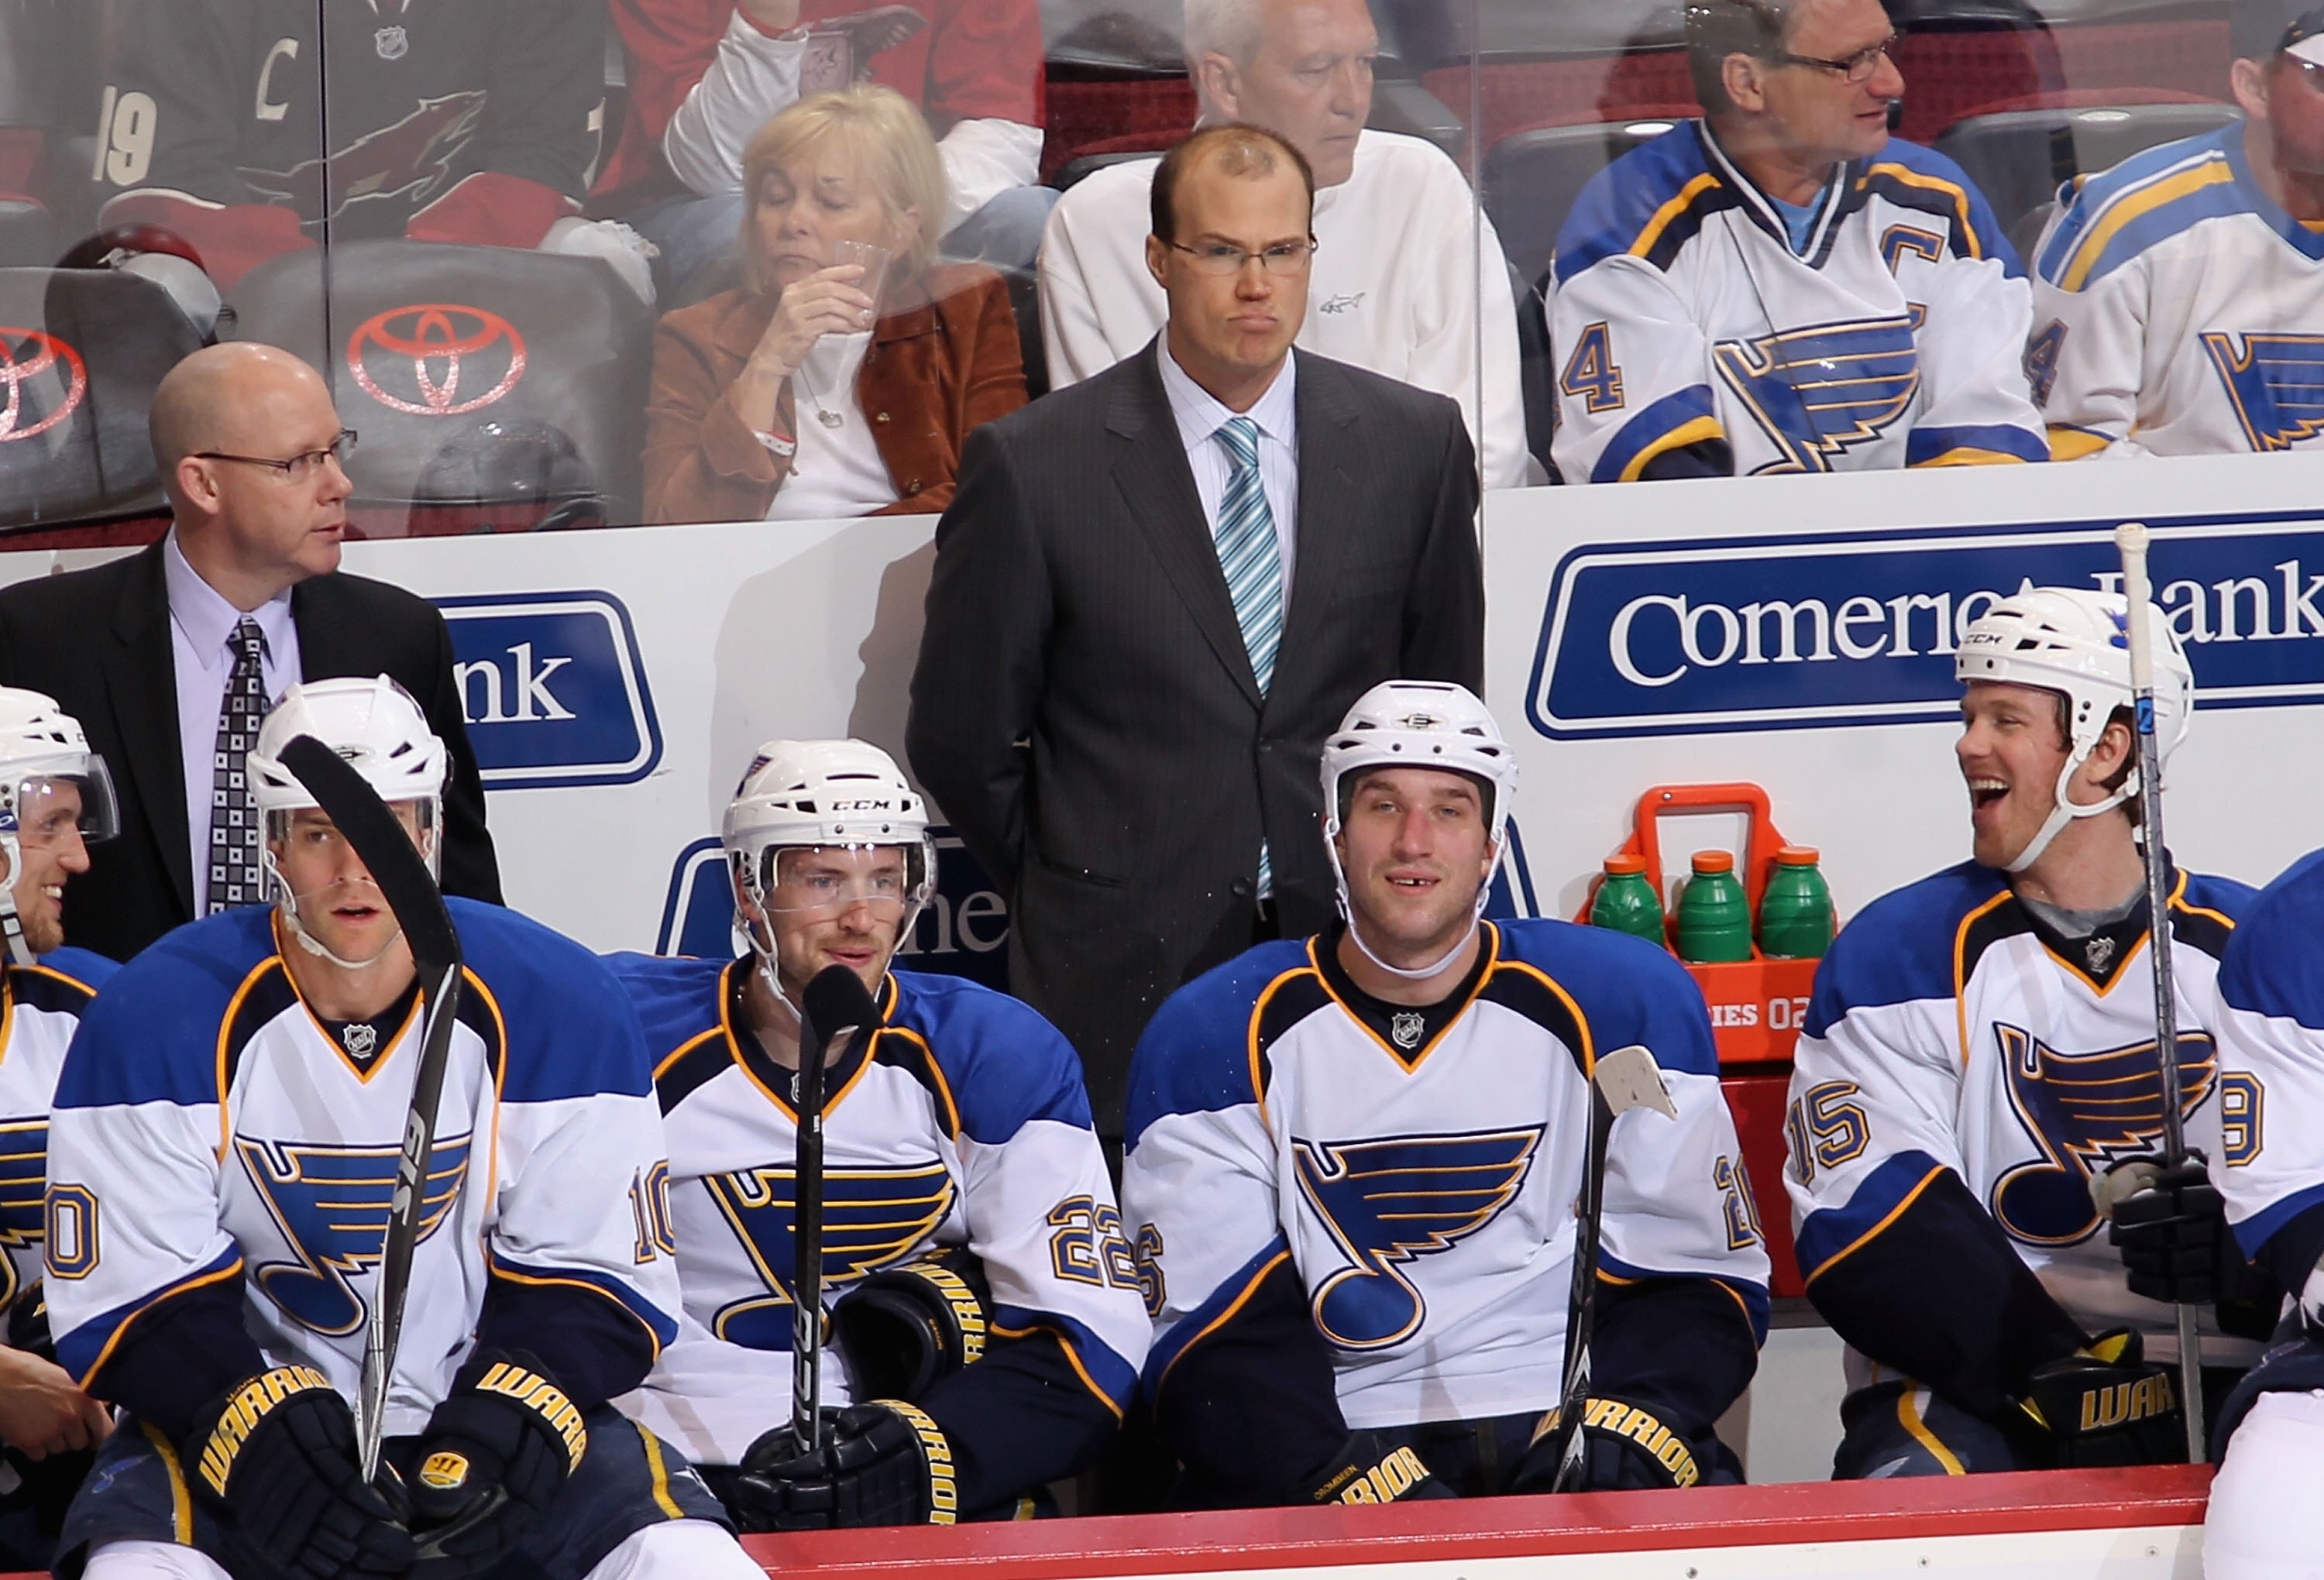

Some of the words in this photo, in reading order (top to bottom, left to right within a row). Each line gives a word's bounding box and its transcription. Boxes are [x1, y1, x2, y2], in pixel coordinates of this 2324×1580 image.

[256, 36, 300, 120] C
[92, 84, 157, 186] 19
[1559, 321, 1625, 414] 4
[1609, 579, 2034, 687] Comeric
[832, 799, 891, 812] CCM
[1708, 1003, 1758, 1027] IES
[1788, 1080, 1871, 1189] 15
[43, 1183, 100, 1279] 0
[1047, 1194, 1143, 1293] 22
[1329, 1445, 1431, 1506] RIOR
